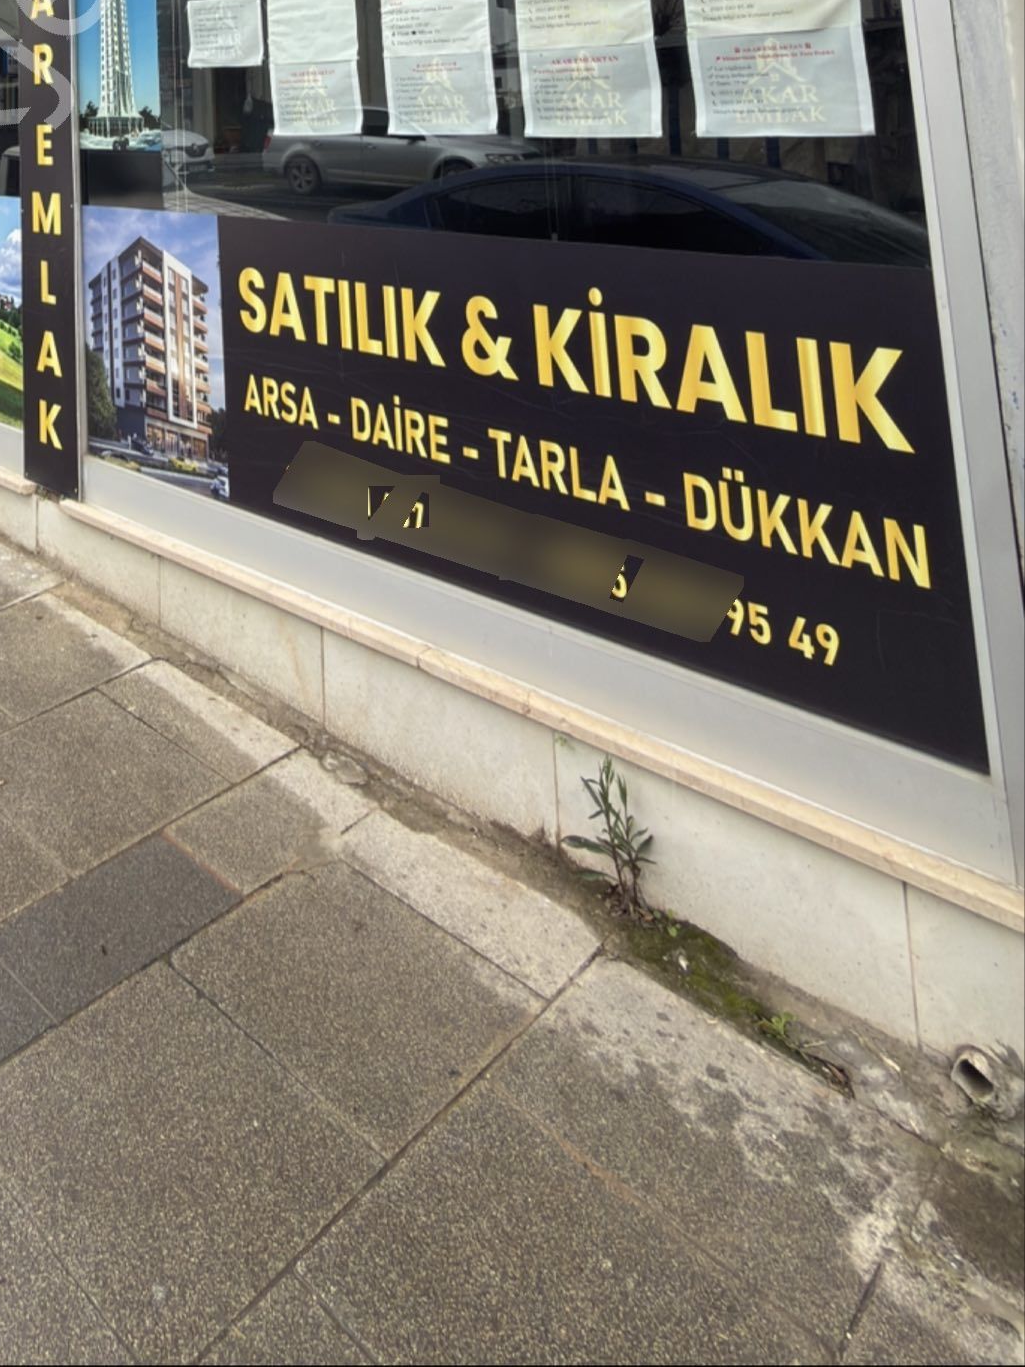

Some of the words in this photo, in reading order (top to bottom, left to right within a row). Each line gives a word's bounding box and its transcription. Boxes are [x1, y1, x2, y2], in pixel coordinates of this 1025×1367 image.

[742, 84, 819, 104] AKAR
[238, 266, 446, 367] SATILIK
[461, 295, 519, 381] &
[533, 287, 916, 454] KİRALIK
[244, 374, 319, 430] ARSA
[350, 395, 451, 464] DAİRE
[487, 428, 631, 511] TARLA
[683, 466, 932, 590] DÜKKAN
[788, 616, 840, 666] 49
